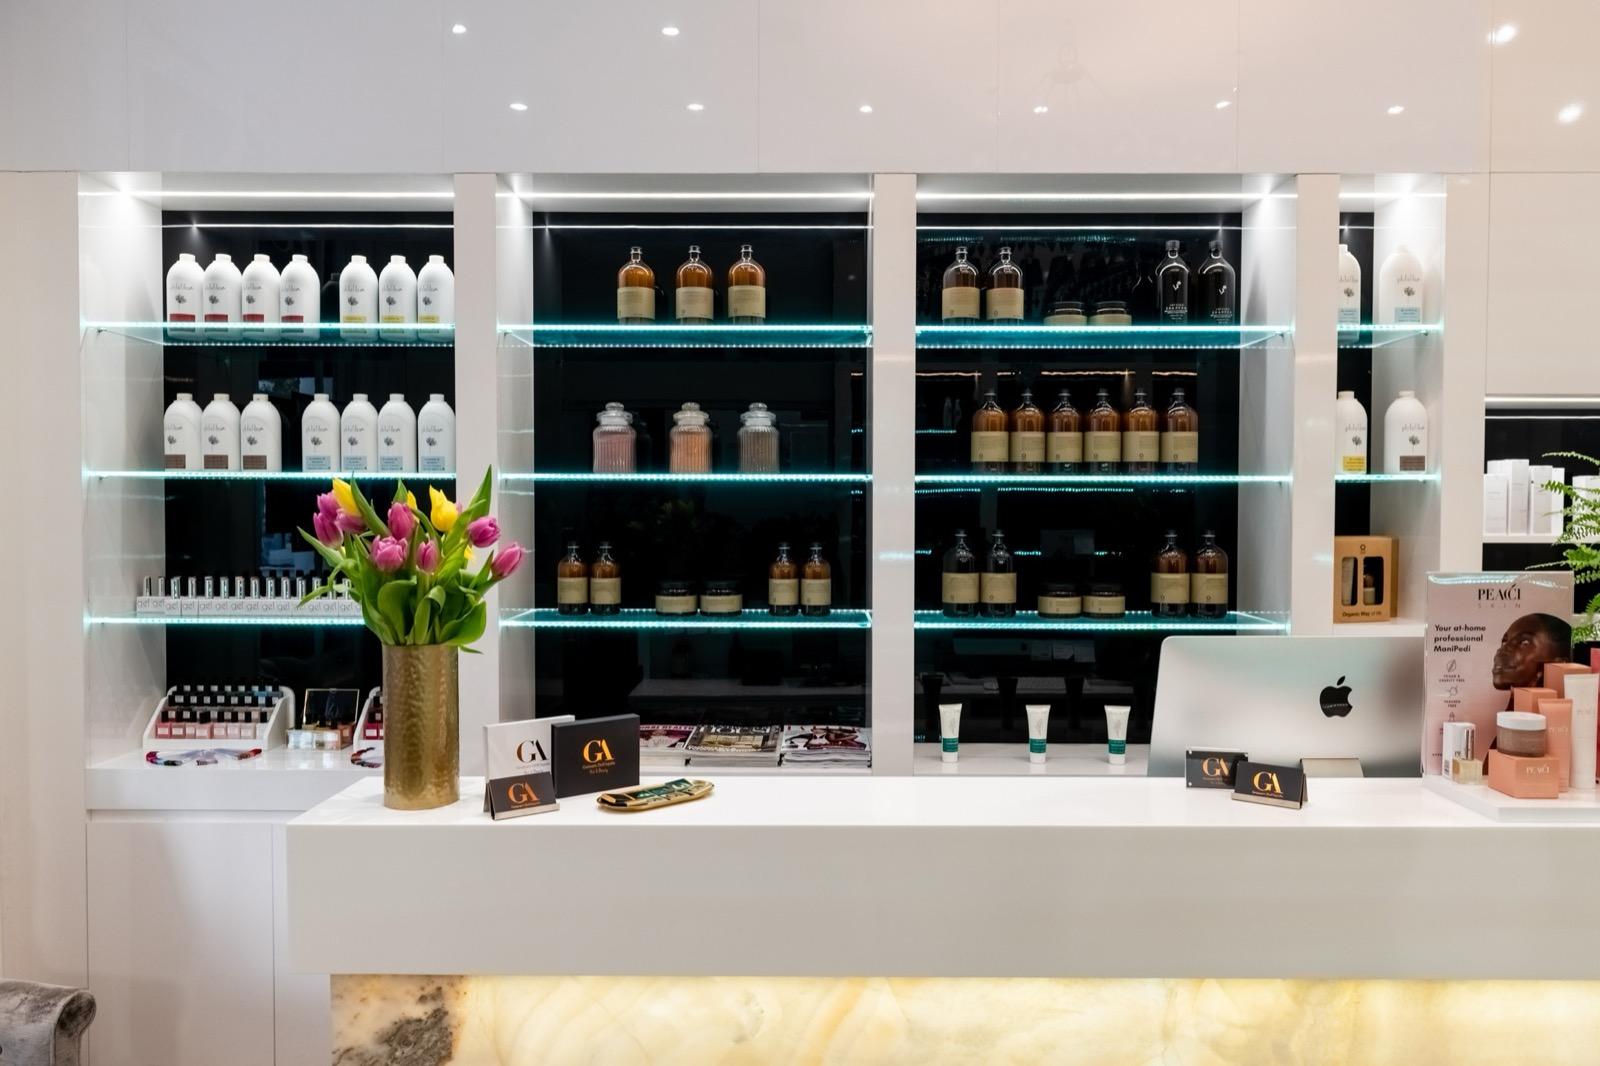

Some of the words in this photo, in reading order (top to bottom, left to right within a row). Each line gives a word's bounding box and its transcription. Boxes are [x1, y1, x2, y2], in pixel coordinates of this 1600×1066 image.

[1434, 633, 1484, 644] professional
[1435, 624, 1451, 632] Your
[1453, 623, 1487, 632] at-home
[1433, 645, 1471, 653] ManiPedi
[516, 738, 549, 764] GA
[582, 738, 615, 764] GA
[1202, 757, 1230, 778] GA
[508, 781, 540, 804] GA
[1253, 771, 1284, 794] GA
